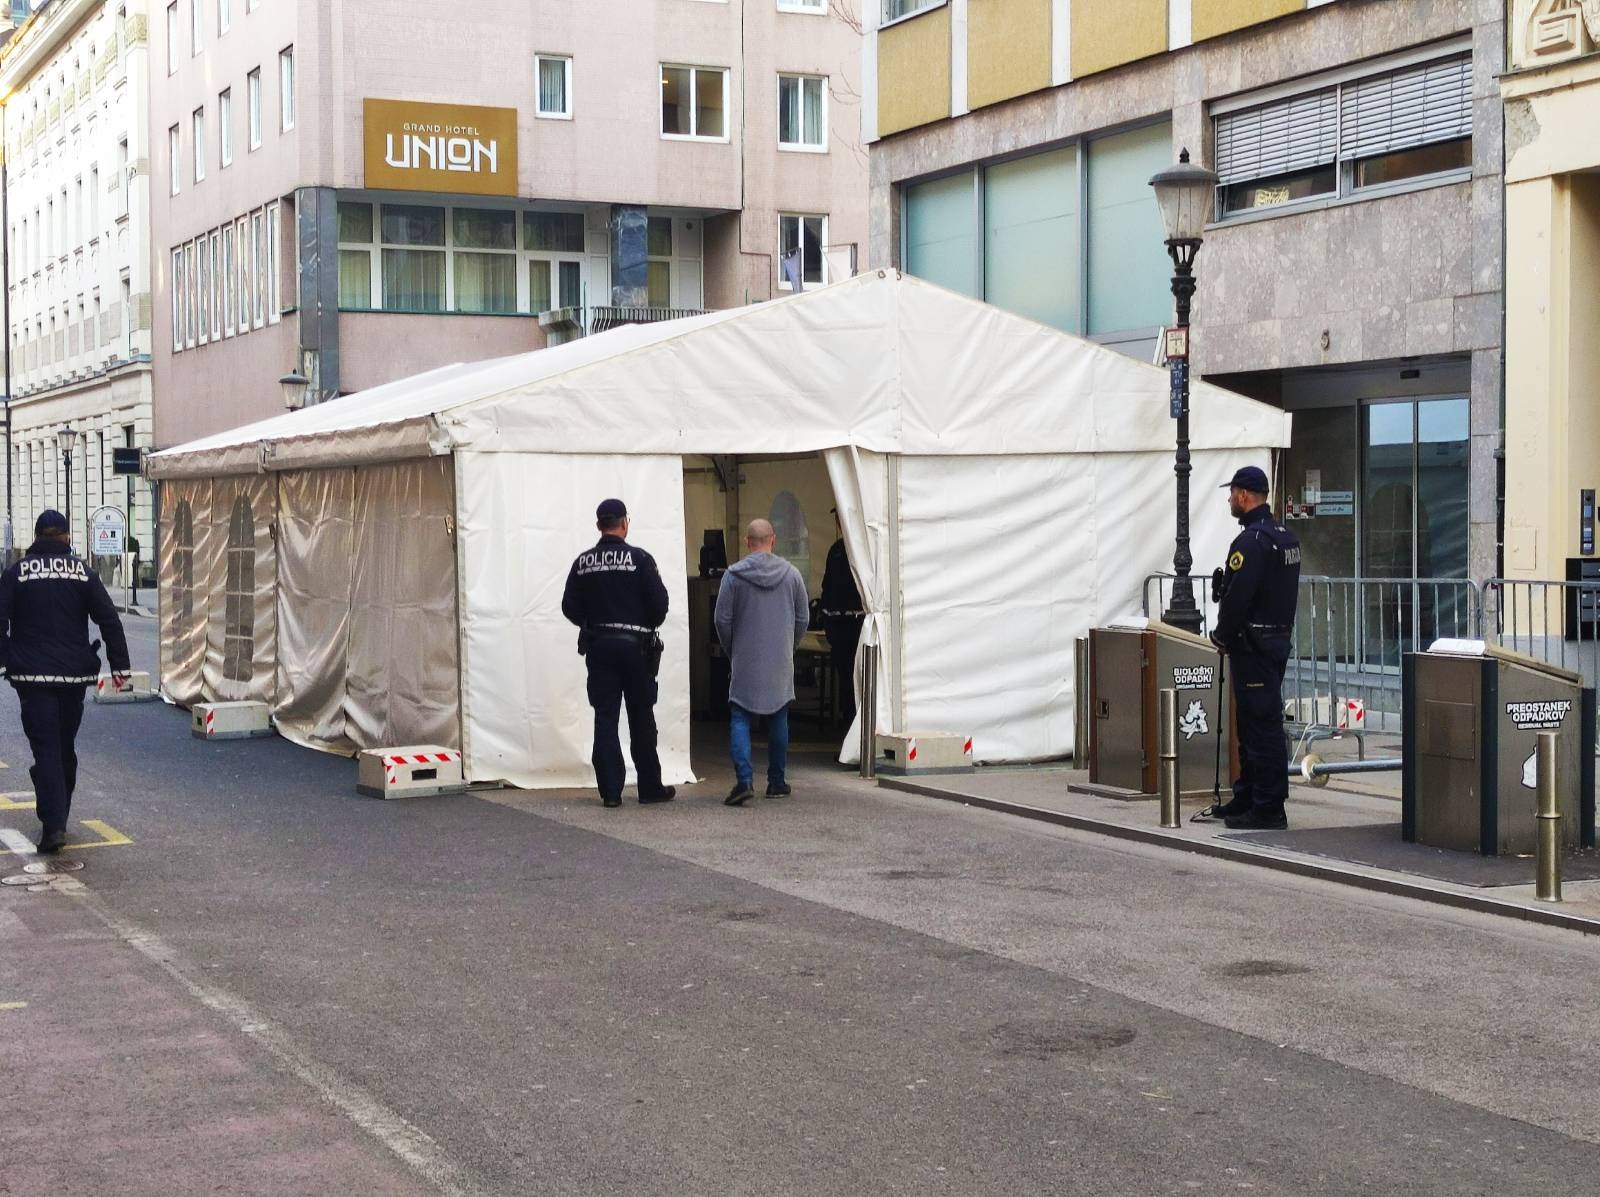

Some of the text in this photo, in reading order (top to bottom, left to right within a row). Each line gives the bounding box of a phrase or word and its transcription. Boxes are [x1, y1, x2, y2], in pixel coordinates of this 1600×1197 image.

[403, 123, 480, 136] GRAND HOTEL
[385, 133, 497, 173] UNION
[19, 557, 86, 576] POLICIJA
[578, 551, 633, 570] POLICIJA
[1173, 665, 1213, 676] BIOLOŠKI
[1174, 675, 1212, 684] ODPADKI
[1506, 700, 1571, 714] PREOSTANEK
[1512, 710, 1566, 722] ODPADKOV
